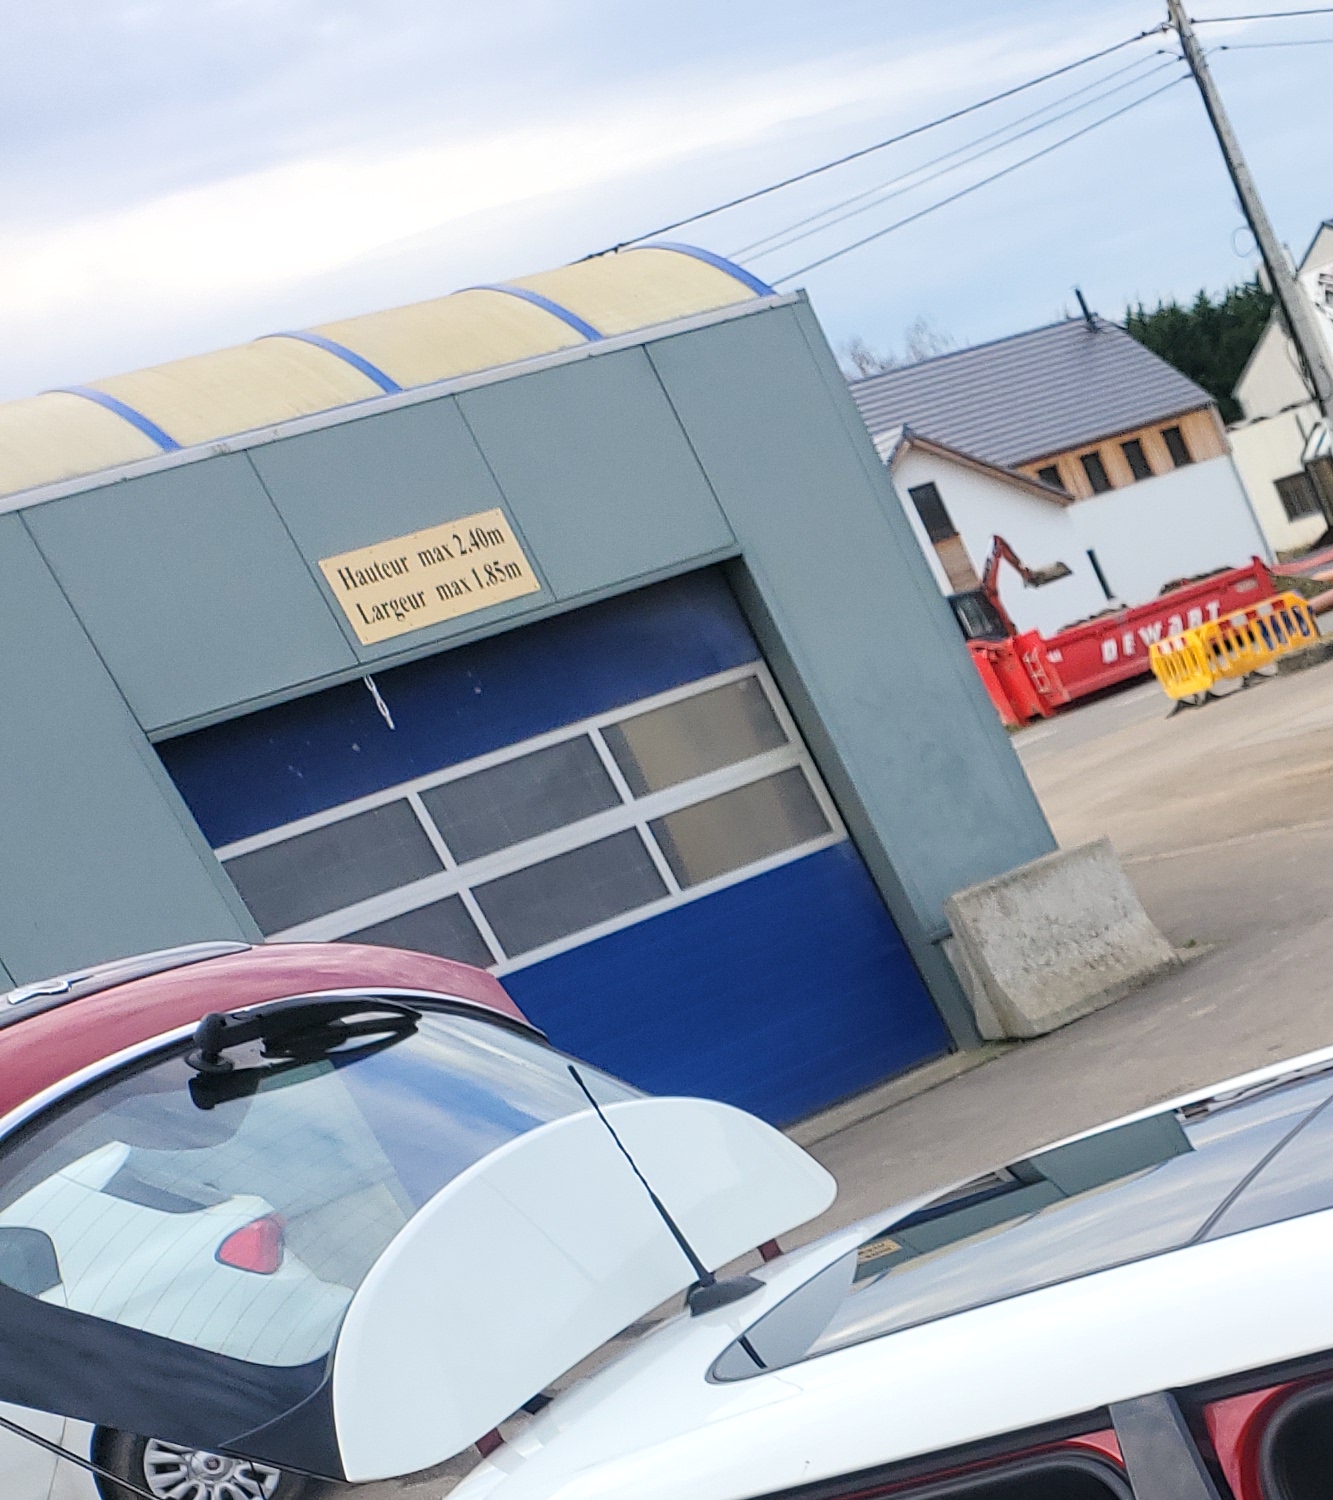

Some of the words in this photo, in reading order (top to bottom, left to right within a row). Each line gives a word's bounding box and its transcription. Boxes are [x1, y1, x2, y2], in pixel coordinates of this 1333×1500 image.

[337, 556, 410, 591] Hauteur
[417, 543, 455, 568] max
[452, 527, 505, 557] 2.40m
[356, 590, 427, 625] Largeur
[435, 578, 473, 602] max
[471, 560, 523, 590] 1.85m
